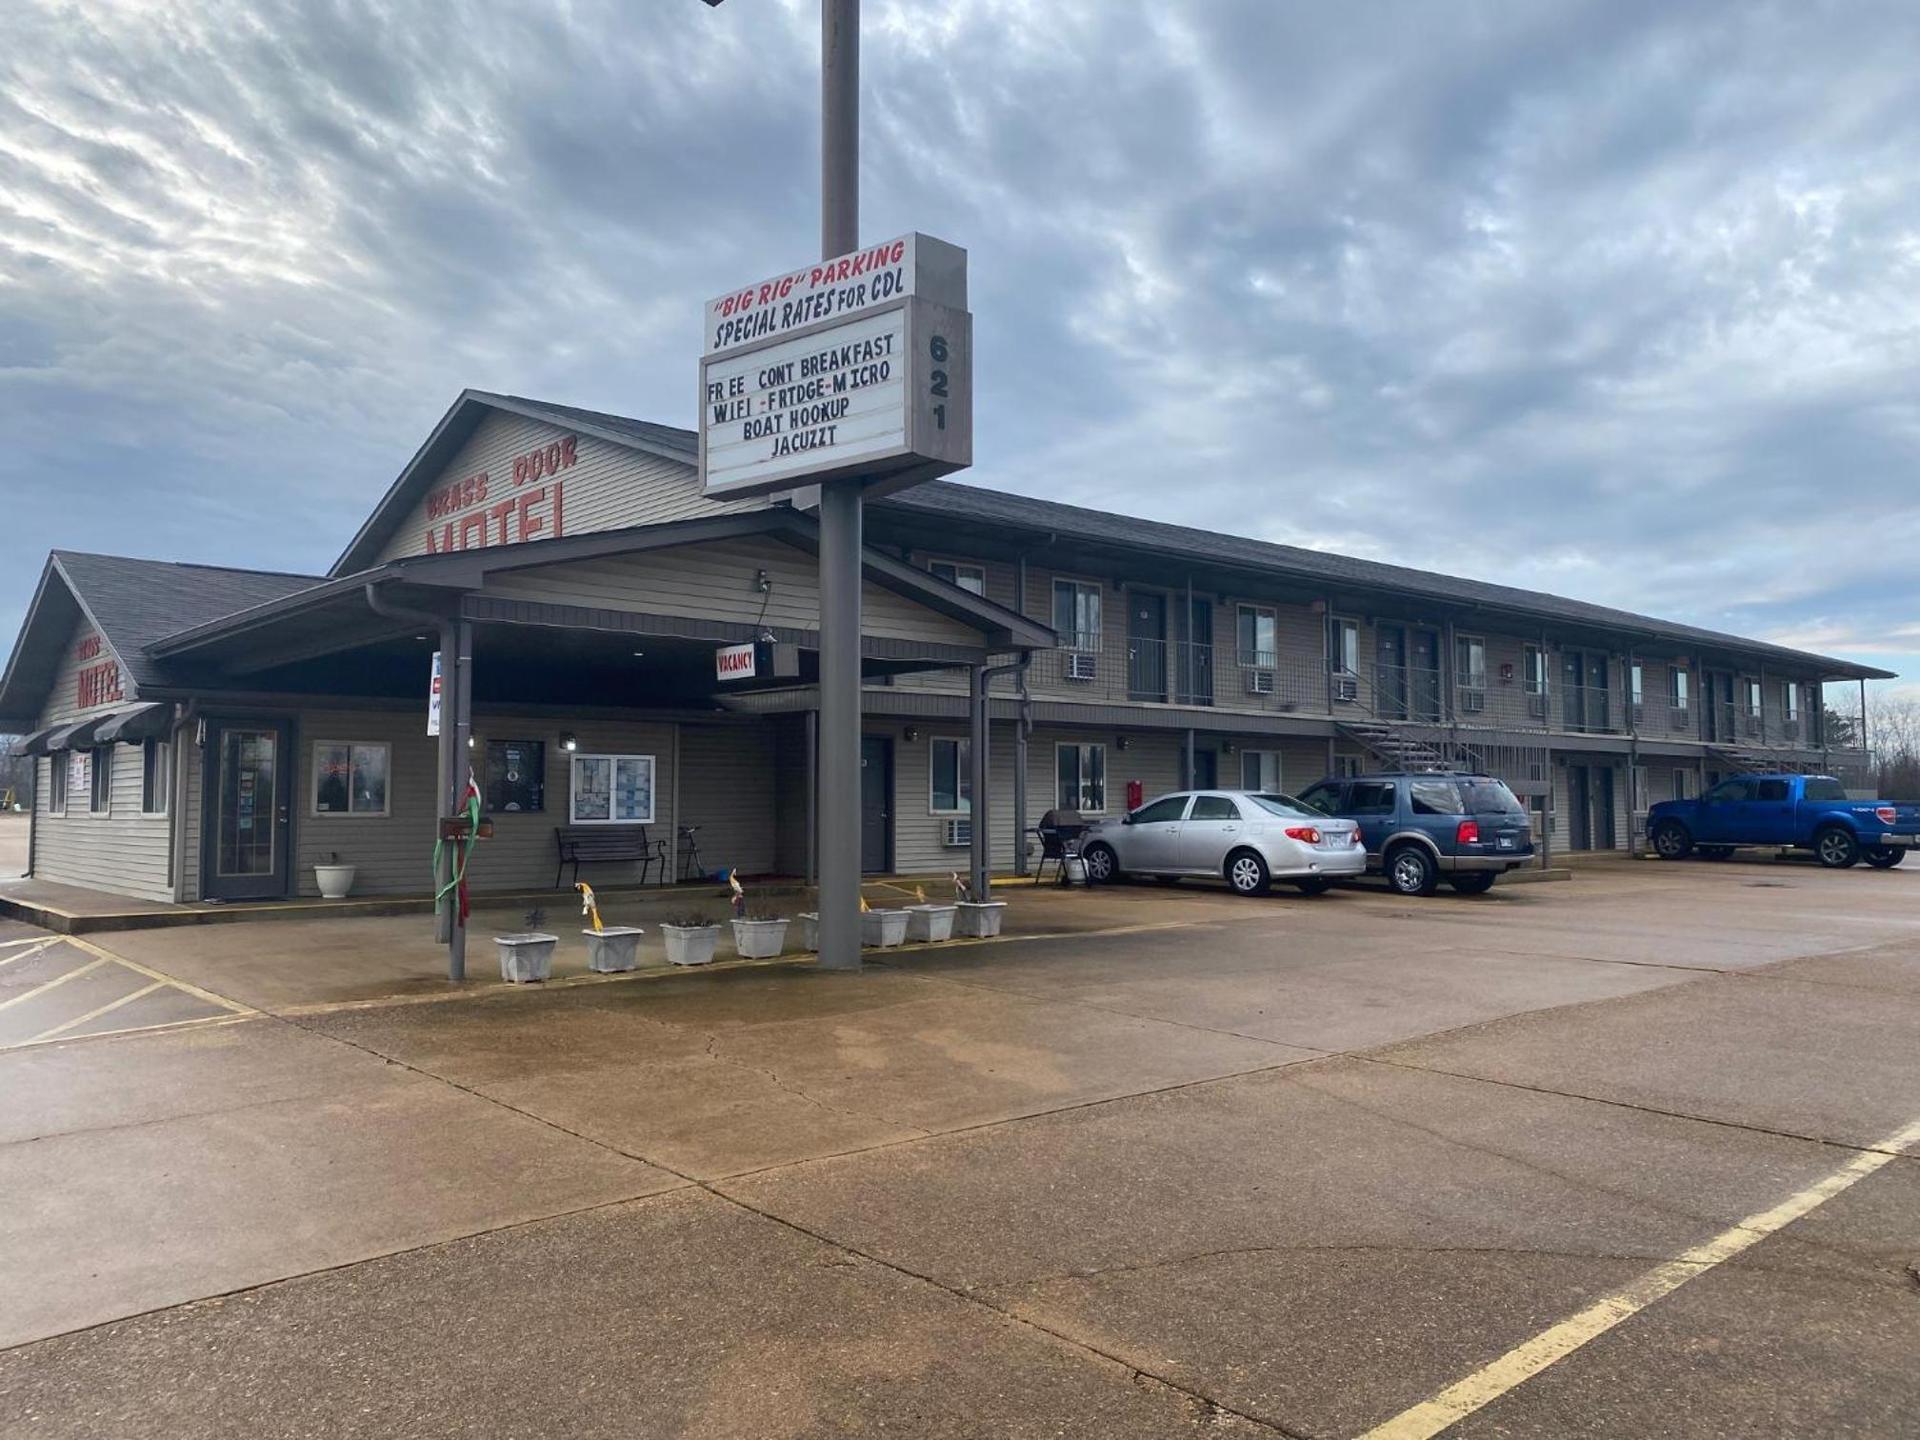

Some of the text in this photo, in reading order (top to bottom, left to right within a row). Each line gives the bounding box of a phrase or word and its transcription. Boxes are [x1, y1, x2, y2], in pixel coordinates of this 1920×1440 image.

[809, 240, 905, 289] PARKING
[713, 267, 904, 349] SPECIAL RATES FOR CDL
[758, 362, 795, 389] CONT
[800, 333, 894, 378] BREAKFAST
[713, 397, 751, 424] WIFI
[743, 397, 850, 440] BOAT HOOKUP
[512, 434, 578, 487] DOOR
[718, 651, 753, 673] VACANCY
